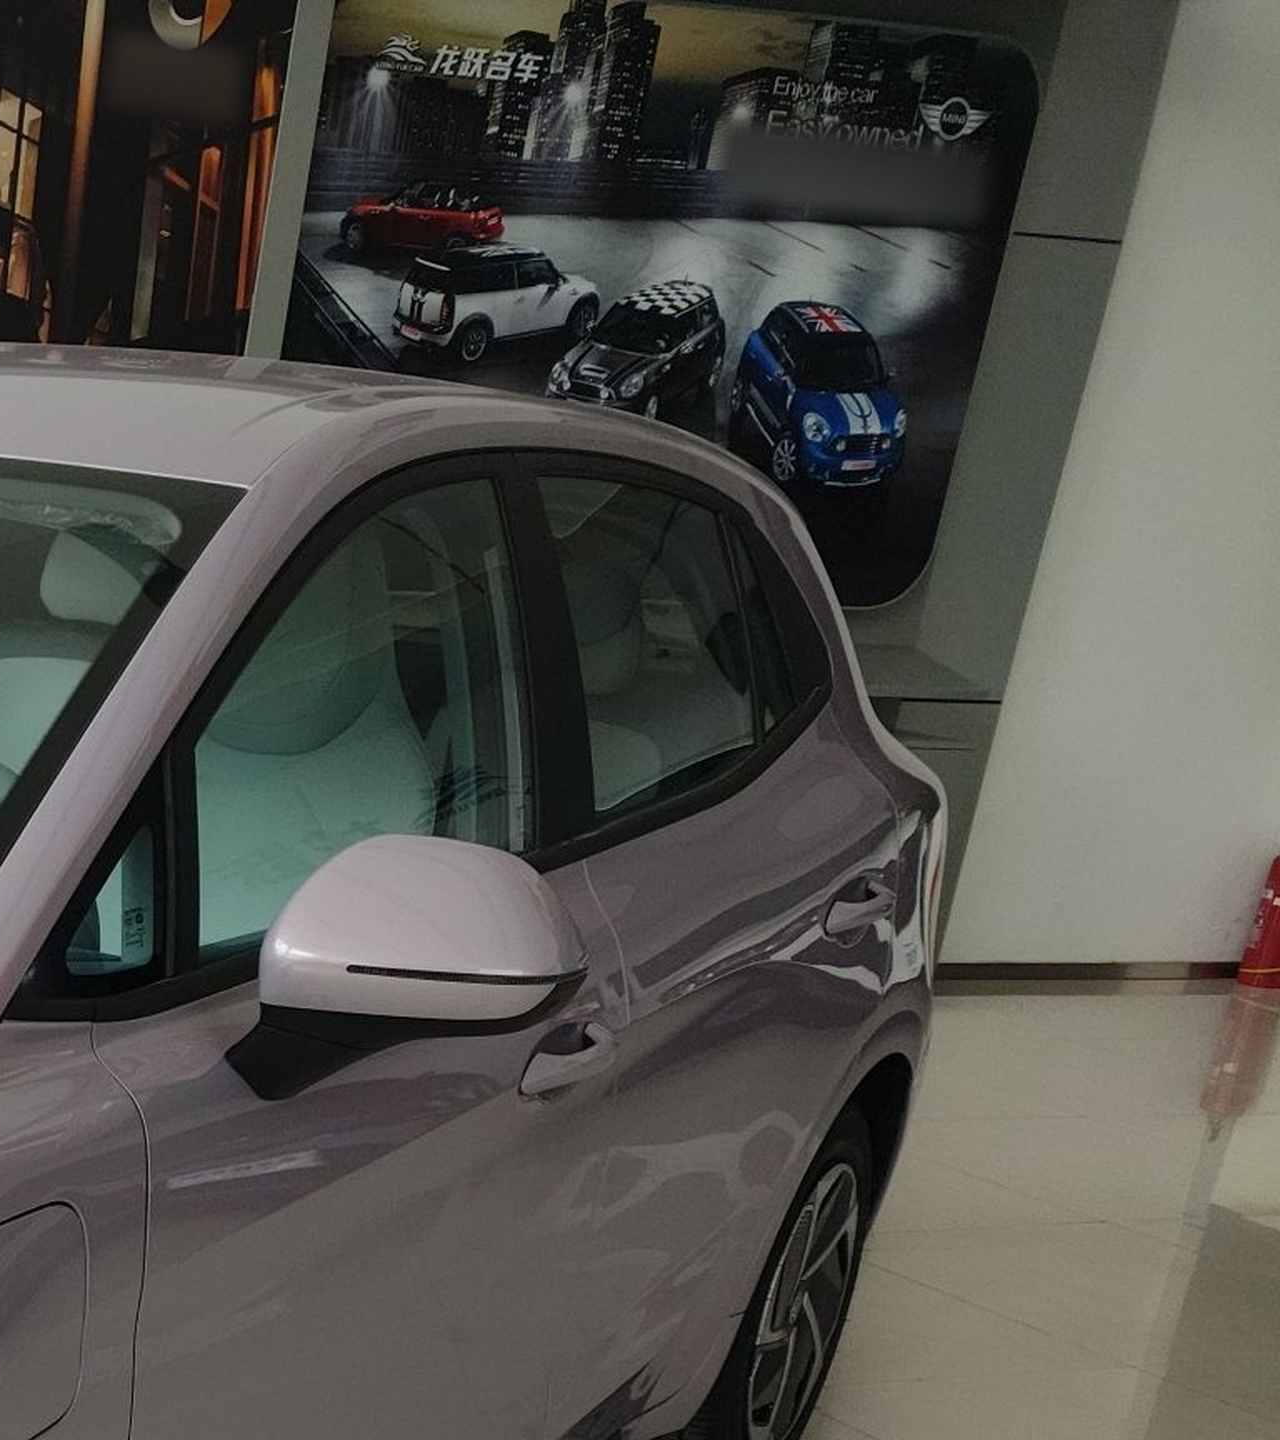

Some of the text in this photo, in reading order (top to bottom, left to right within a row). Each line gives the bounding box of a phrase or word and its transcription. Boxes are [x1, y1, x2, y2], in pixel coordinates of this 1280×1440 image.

[429, 44, 544, 83] 龙跃名车
[772, 76, 879, 103] Enjoy the car
[941, 112, 966, 125] MINI
[836, 123, 924, 150] owned
